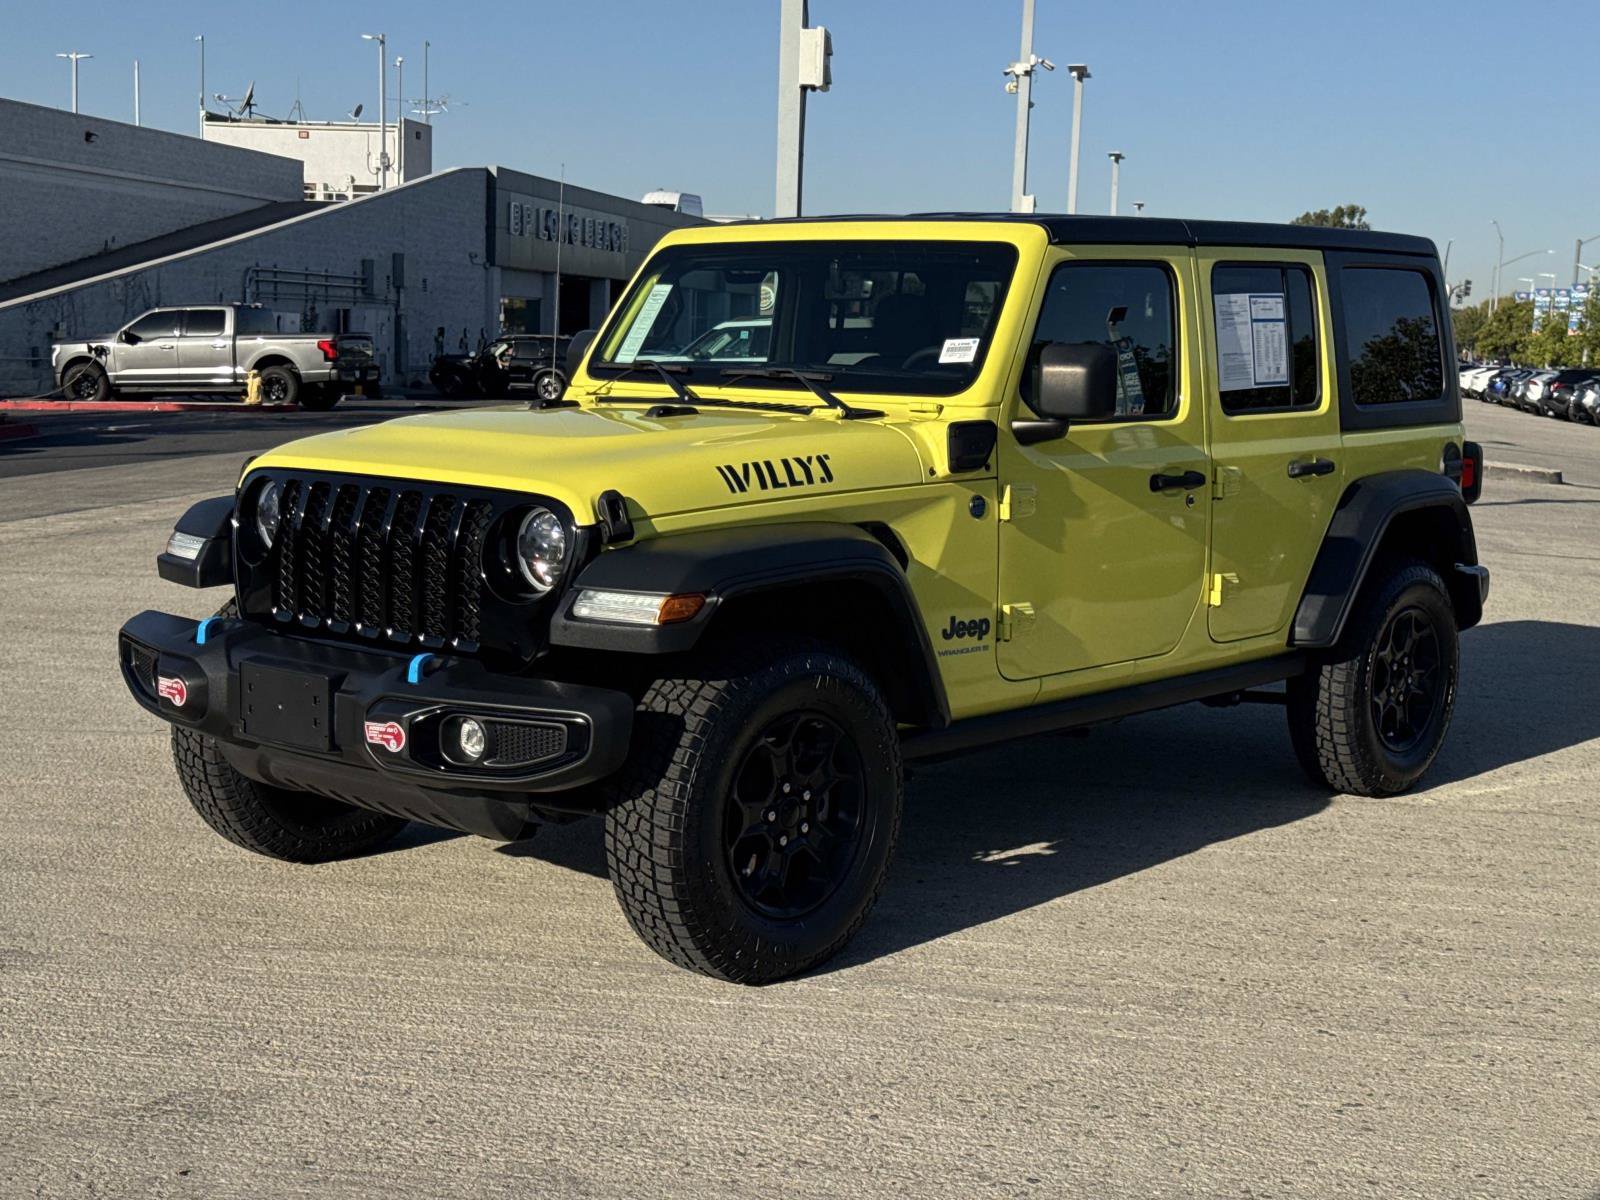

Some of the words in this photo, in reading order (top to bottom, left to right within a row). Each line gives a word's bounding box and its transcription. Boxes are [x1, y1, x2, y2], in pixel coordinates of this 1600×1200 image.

[539, 208, 582, 245] LONG
[584, 217, 630, 253] BEACH
[715, 454, 834, 494] WILLYS
[942, 615, 990, 641] Jeep
